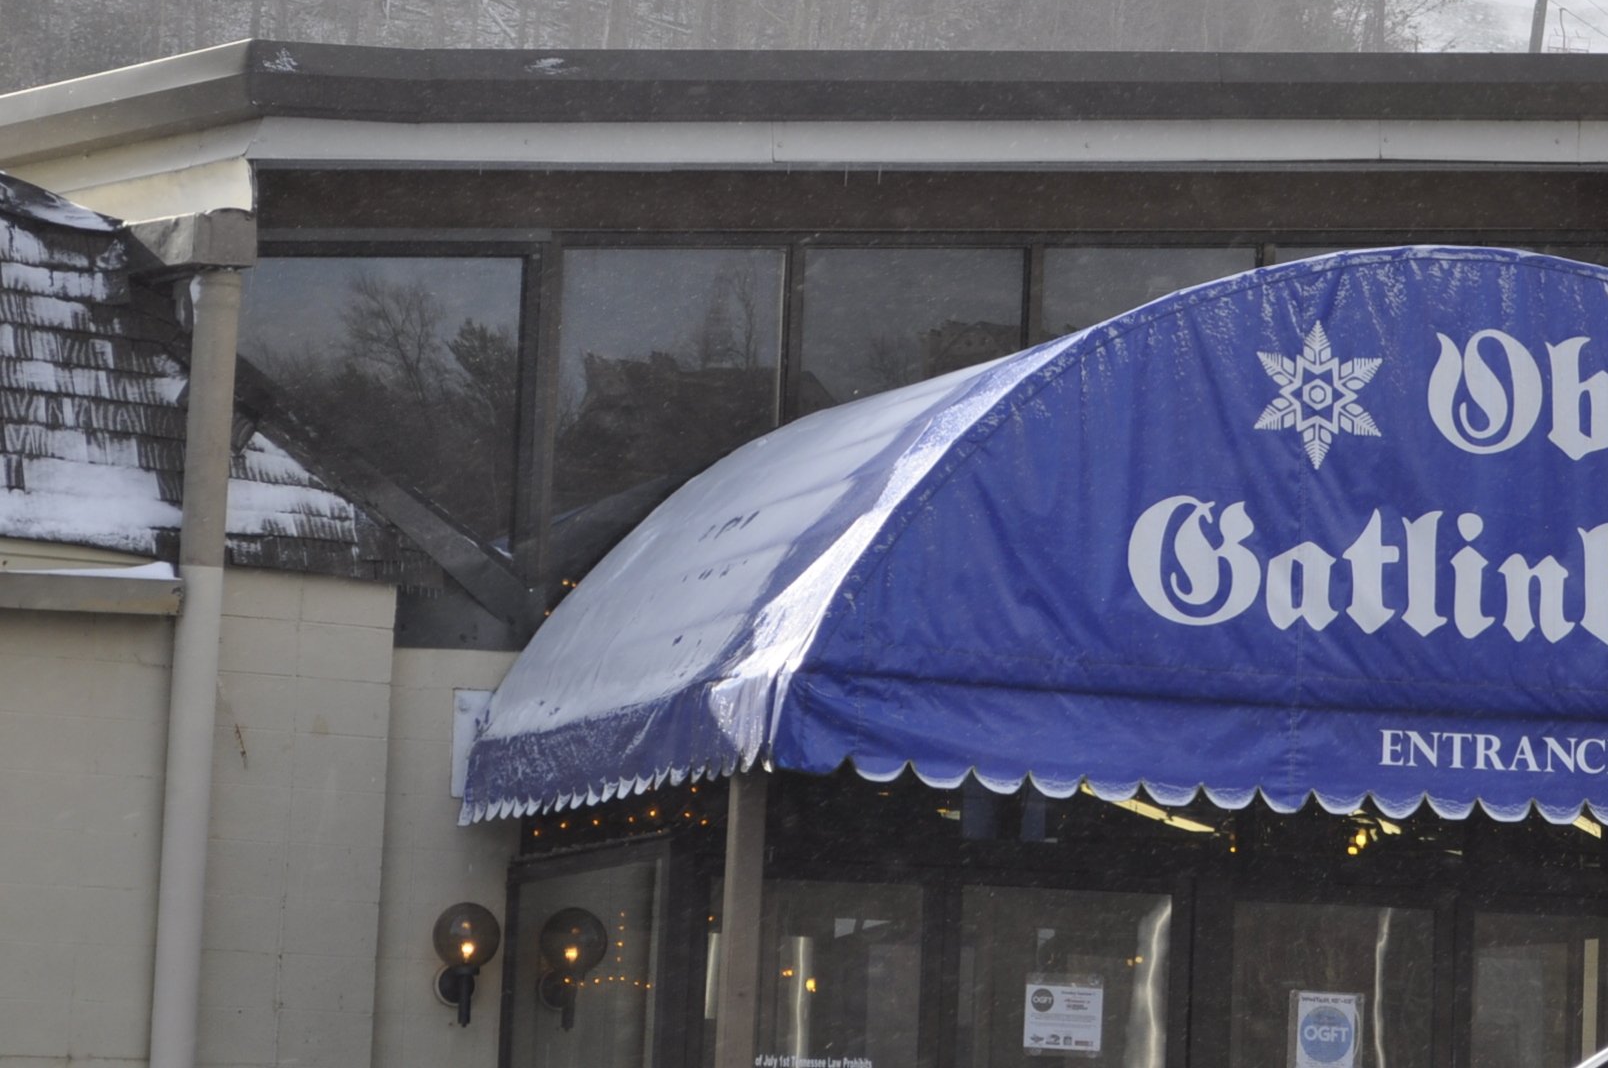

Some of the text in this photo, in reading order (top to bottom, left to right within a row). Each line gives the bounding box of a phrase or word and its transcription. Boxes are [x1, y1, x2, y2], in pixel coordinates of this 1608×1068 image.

[1304, 1025, 1349, 1043] OGFT
[755, 1054, 763, 1066] of
[763, 1054, 777, 1068] July
[828, 1057, 842, 1068] Law
[843, 1057, 872, 1068] Prohibits
